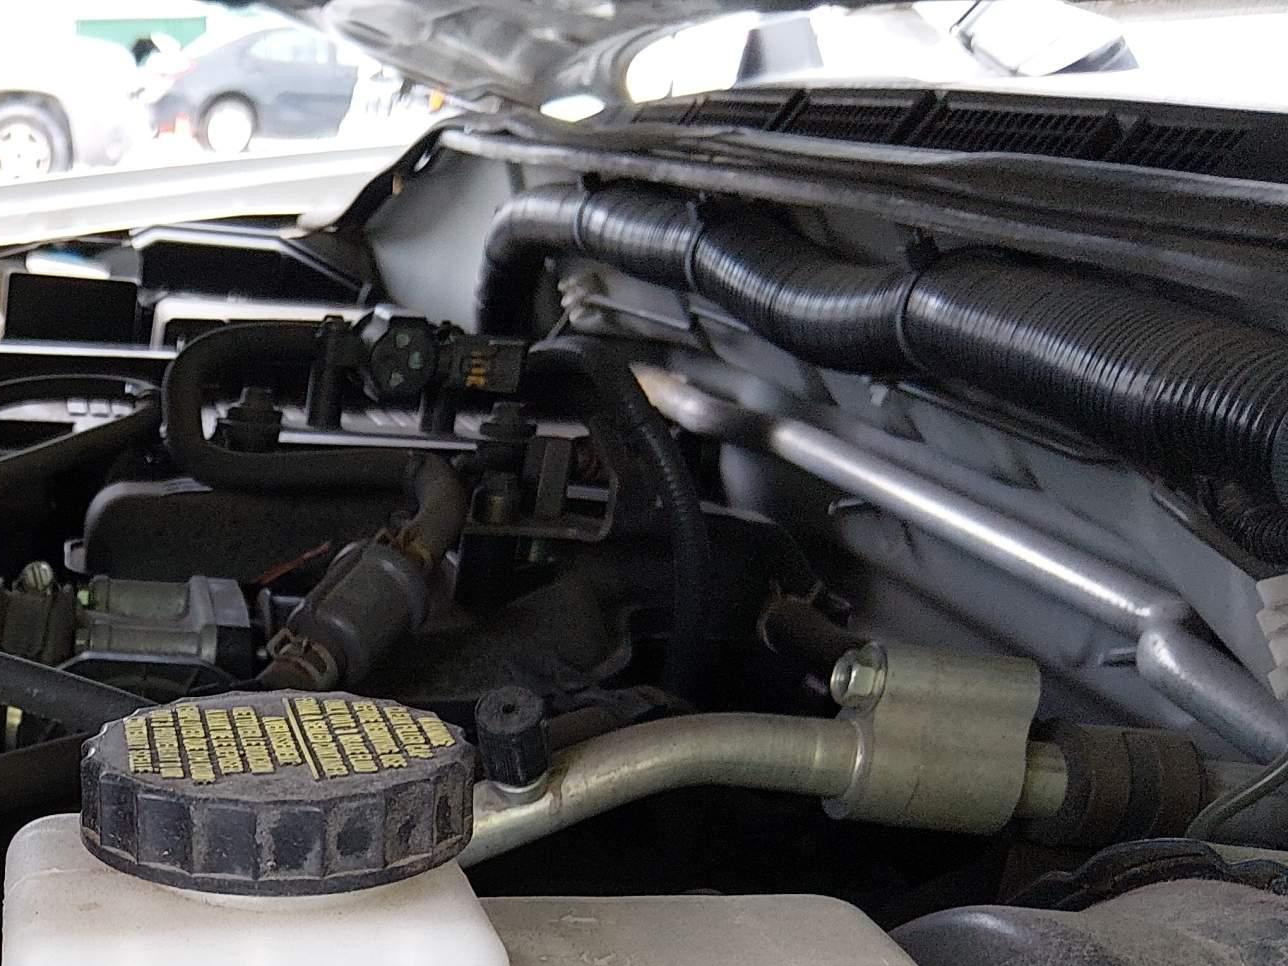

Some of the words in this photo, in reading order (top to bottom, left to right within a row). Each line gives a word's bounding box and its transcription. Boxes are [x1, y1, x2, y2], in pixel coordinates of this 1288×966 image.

[293, 697, 322, 714] FROM
[322, 699, 351, 713] ONLY
[350, 701, 385, 722] BEFORE
[204, 709, 231, 730] AVANT
[230, 705, 262, 737] NETTOYER
[328, 714, 358, 727] DOT
[381, 706, 415, 724] CLEAN
[210, 730, 234, 738] DE
[302, 720, 334, 741] SEALED
[392, 724, 427, 744] FILLER
[182, 738, 208, 750] QUE
[213, 738, 236, 746] LE
[240, 737, 266, 745] LE
[337, 734, 370, 754] BRAKE
[242, 746, 275, 772] BOUCHON
[403, 744, 434, 757] CAP
[347, 754, 379, 772] FLUID
